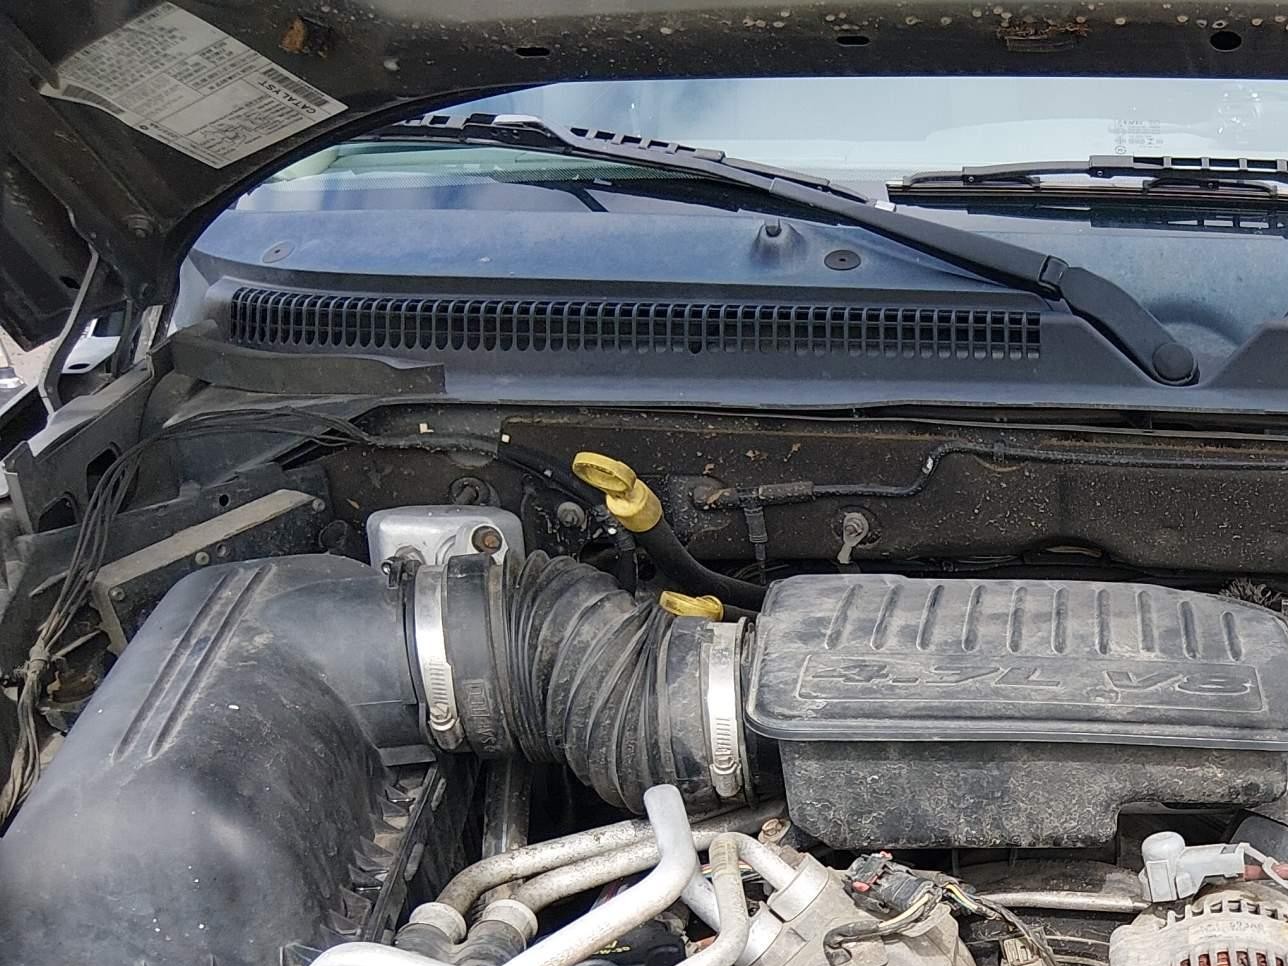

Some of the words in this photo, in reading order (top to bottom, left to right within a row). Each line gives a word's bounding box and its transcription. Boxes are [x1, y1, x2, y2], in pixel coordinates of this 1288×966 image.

[257, 80, 317, 114] CATALYST
[811, 662, 1062, 687] 4.7L
[1104, 668, 1256, 696] V8
